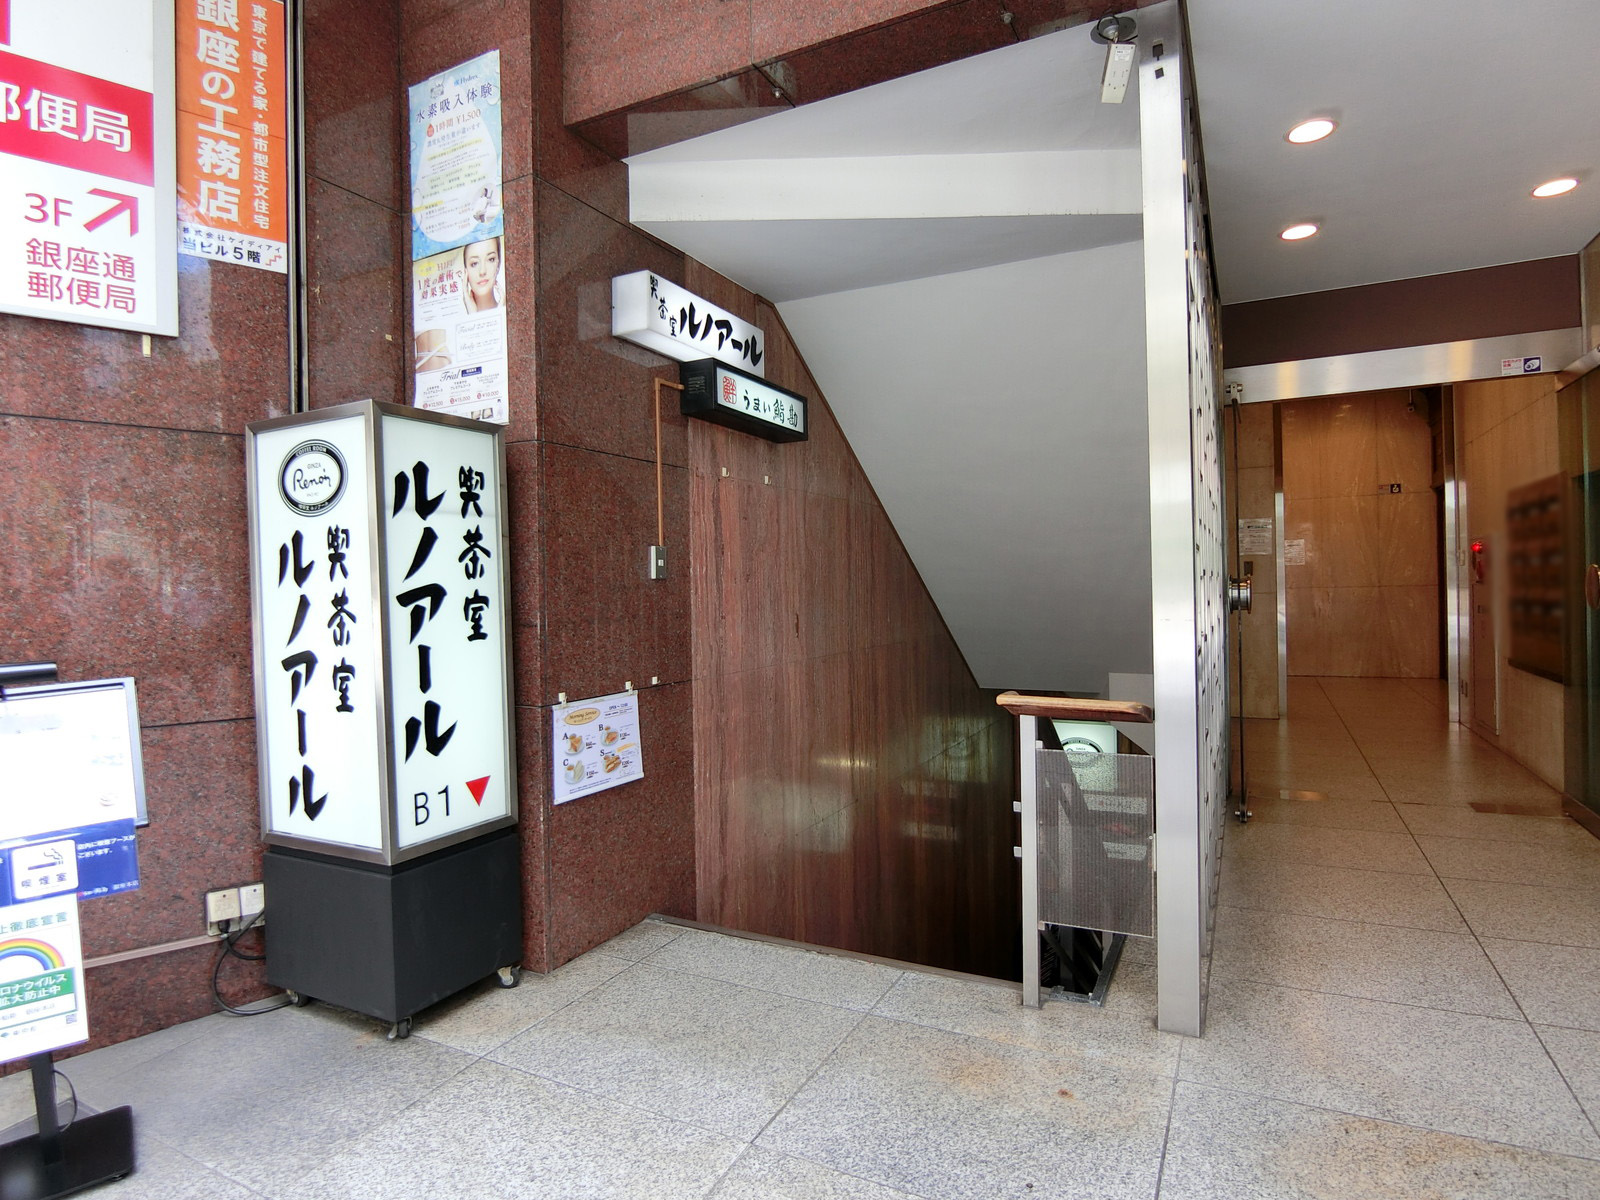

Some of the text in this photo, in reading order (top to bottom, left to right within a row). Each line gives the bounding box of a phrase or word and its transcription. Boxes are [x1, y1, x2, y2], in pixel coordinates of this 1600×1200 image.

[196, 0, 242, 223] 銀座の工務店
[416, 82, 493, 123] 水素吸入体験
[24, 193, 73, 227] 3F
[26, 237, 136, 283] 銀座通
[183, 237, 262, 264] 当ビル5階
[27, 272, 137, 314] 郵便局
[650, 274, 763, 367] 喫茶室 ルノアール
[439, 368, 461, 382] Trial
[457, 465, 492, 642] 喫茶室
[327, 524, 357, 713] 喫茶室
[392, 460, 458, 765] ルノアール
[277, 529, 328, 822] ルノアール
[562, 732, 569, 740] A
[598, 724, 604, 732] B
[562, 759, 569, 767] C
[414, 785, 451, 827] B1
